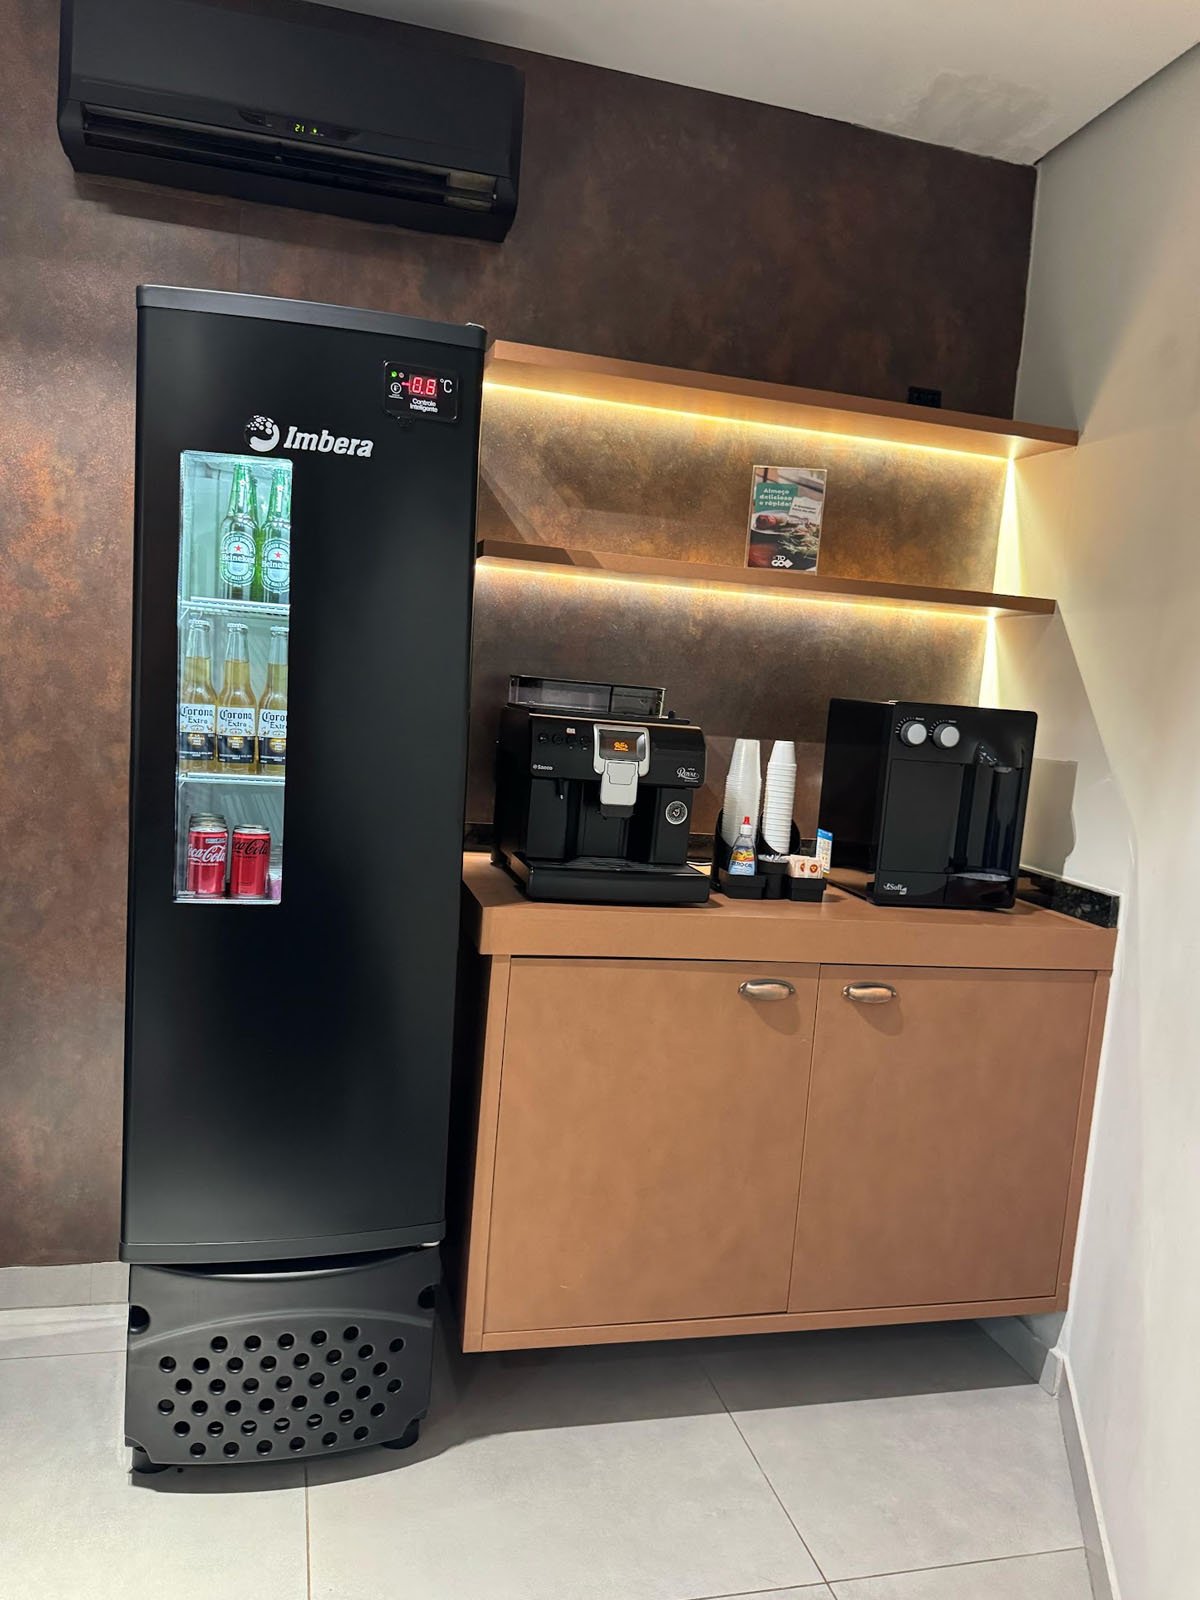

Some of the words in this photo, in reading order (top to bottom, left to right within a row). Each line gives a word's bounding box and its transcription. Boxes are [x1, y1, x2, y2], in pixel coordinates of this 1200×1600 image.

[294, 123, 305, 133] 21
[412, 398, 437, 407] Controle
[409, 403, 439, 413] Inteligente
[283, 426, 374, 458] Imbera
[180, 706, 214, 717] Corona
[219, 709, 253, 721] Corona
[188, 717, 208, 725] Extra
[261, 711, 287, 723] Coro
[269, 722, 286, 730] Extr
[187, 844, 225, 862] oca-Cola
